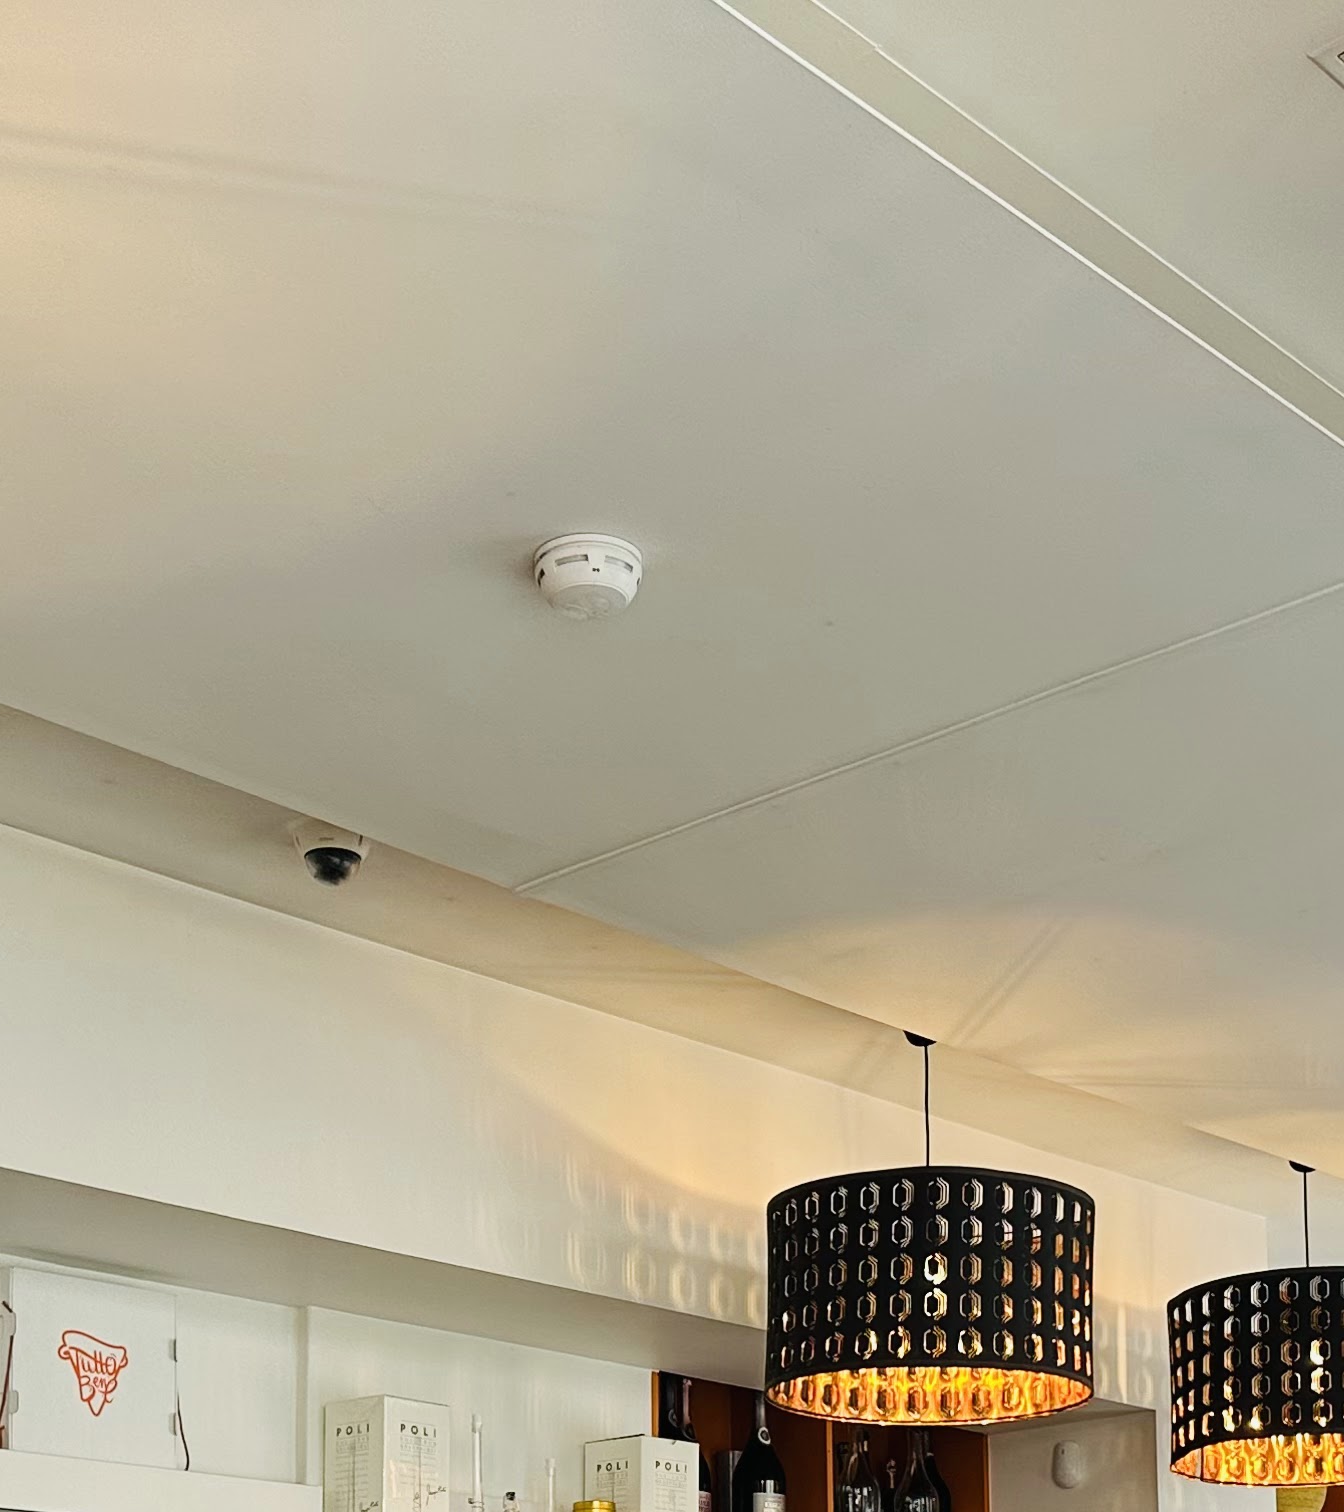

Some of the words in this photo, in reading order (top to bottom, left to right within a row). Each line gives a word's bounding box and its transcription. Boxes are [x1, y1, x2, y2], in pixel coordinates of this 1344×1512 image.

[336, 1423, 370, 1437] POLI
[400, 1423, 437, 1438] POLI
[597, 1460, 628, 1473] POLI
[655, 1460, 687, 1473] POLI
